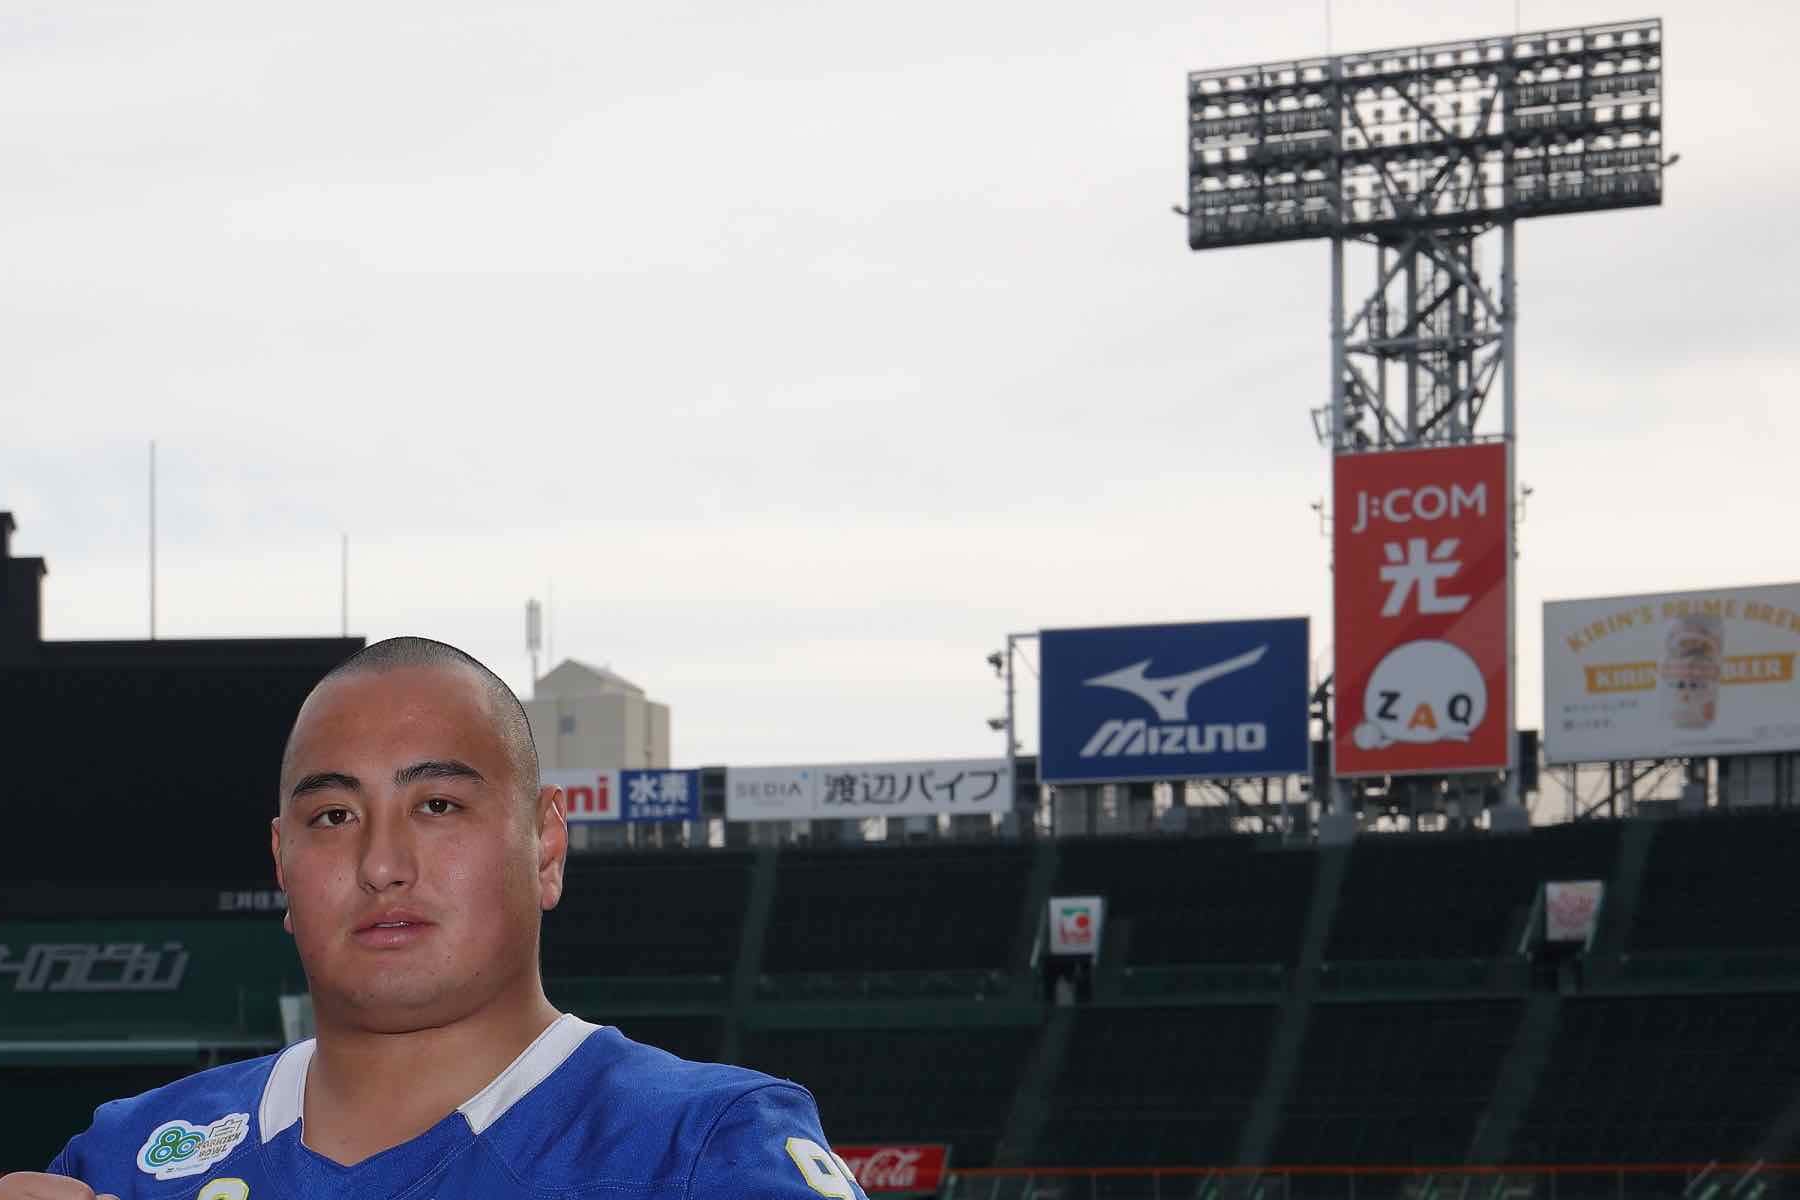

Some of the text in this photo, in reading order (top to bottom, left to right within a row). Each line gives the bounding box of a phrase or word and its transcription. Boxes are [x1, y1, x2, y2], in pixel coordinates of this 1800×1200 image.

[1351, 481, 1487, 534] J:COM
[1379, 536, 1472, 618] 光
[824, 767, 1008, 806] 渡辺パイプ
